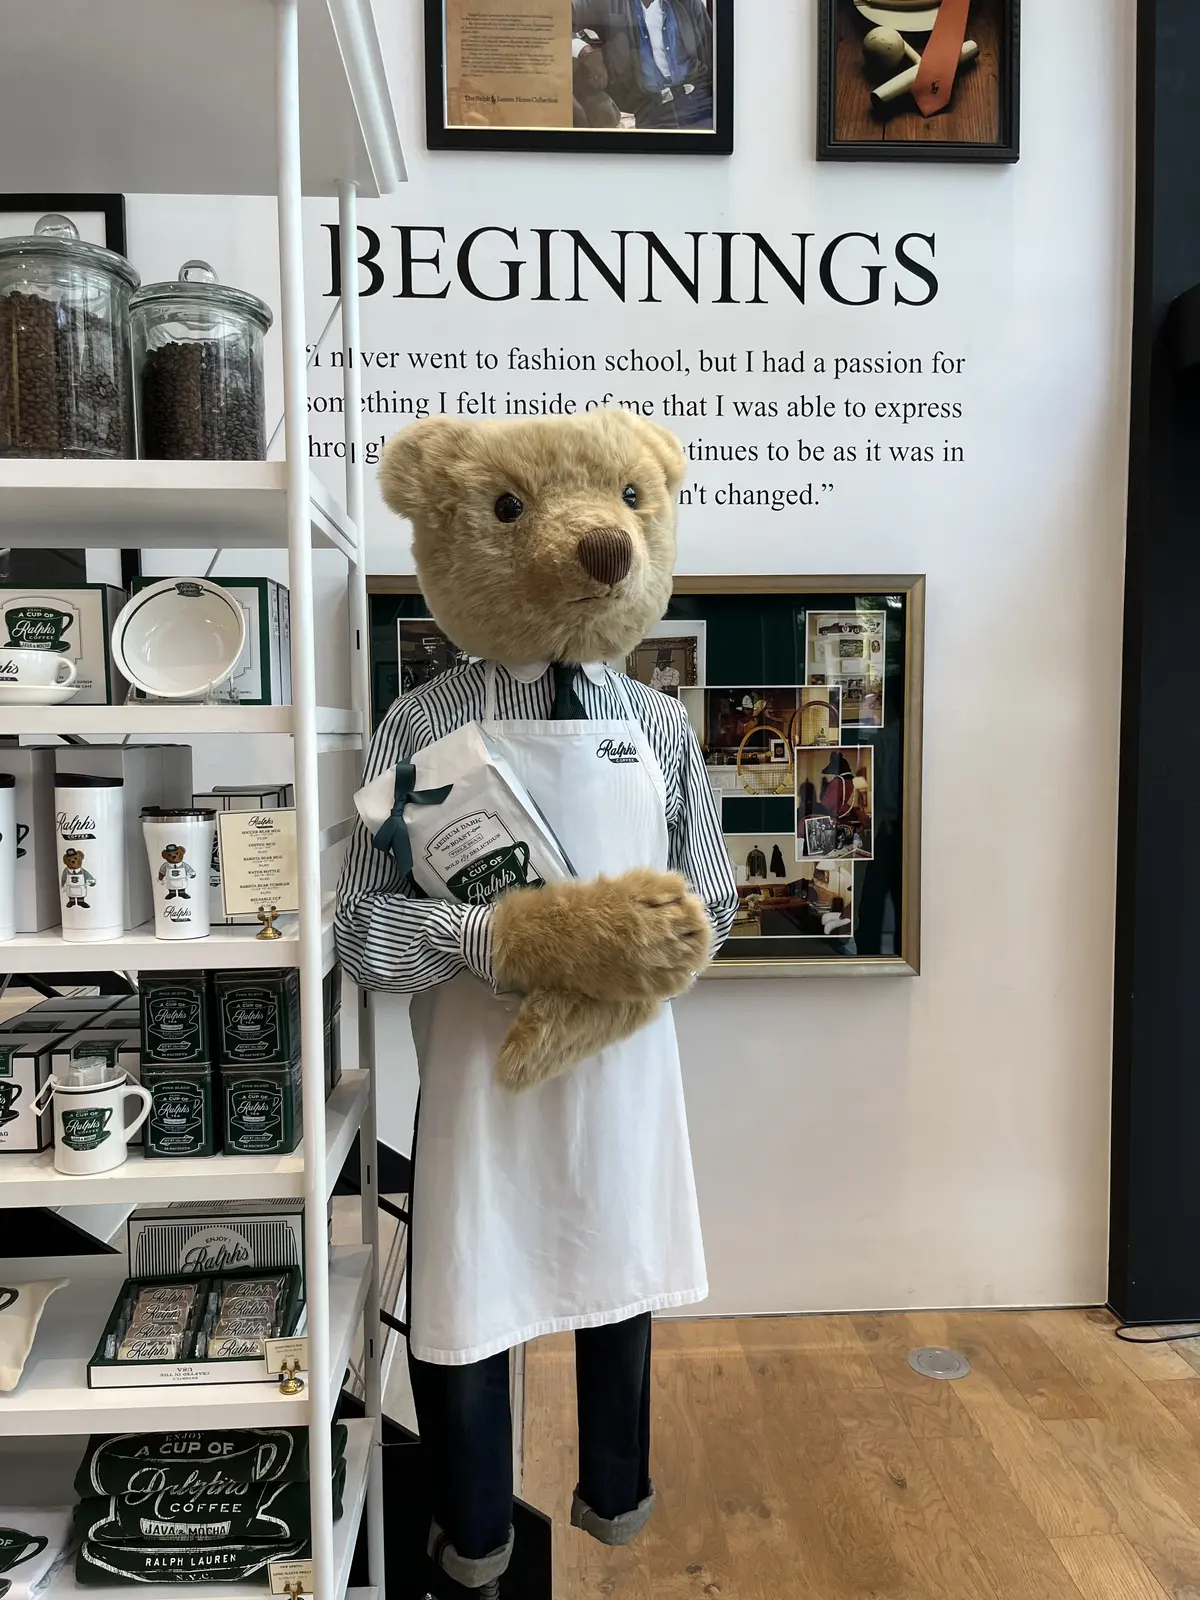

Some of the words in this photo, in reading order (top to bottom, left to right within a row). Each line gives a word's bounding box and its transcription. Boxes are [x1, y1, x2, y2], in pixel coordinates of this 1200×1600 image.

[320, 223, 939, 306] BEGINNINGS
[330, 347, 400, 369] nver
[408, 349, 468, 369] went
[476, 350, 499, 370] to
[507, 347, 597, 371] fashion
[604, 348, 691, 377] school,
[698, 350, 737, 373] but
[745, 350, 754, 373] I
[762, 351, 806, 373] had
[813, 355, 827, 374] a
[832, 350, 923, 379] passion
[931, 351, 966, 374] for
[439, 391, 448, 414] I
[456, 391, 498, 415] felt
[504, 391, 578, 415] inside
[585, 392, 614, 412] of
[618, 400, 655, 416] me
[662, 394, 708, 417] that
[715, 394, 725, 417] I
[732, 400, 779, 418] was
[786, 395, 836, 418] able
[844, 398, 867, 418] to
[874, 401, 963, 424] express
[766, 441, 790, 462] to
[797, 439, 825, 462] be
[833, 443, 858, 462] as
[865, 439, 882, 462] it
[888, 444, 934, 462] was
[942, 440, 965, 462] in
[714, 483, 834, 511] changed.”
[12, 620, 56, 641] Ralph's
[596, 738, 638, 760] Ralph's
[56, 811, 96, 835] Ralph's
[434, 827, 460, 851] MEDIUM
[460, 817, 484, 830] DARK
[449, 830, 472, 847] ROAST
[444, 860, 460, 871] BOLD
[469, 833, 501, 856] DELICIOUS
[461, 876, 468, 884] A
[469, 864, 488, 877] CUP
[489, 856, 503, 866] OF
[467, 868, 517, 905] Ralph's
[163, 905, 192, 919] Ralph's
[158, 1103, 190, 1119] Ralph's
[237, 1101, 269, 1116] Ralph's
[65, 1118, 100, 1136] Ralph's
[181, 1242, 250, 1273] Ralph's
[165, 1432, 205, 1441] ENJOY
[134, 1445, 149, 1457] A
[160, 1442, 201, 1454] CUP
[207, 1441, 235, 1454] OF
[170, 1503, 243, 1513] COFFEE
[145, 1523, 175, 1535] JAVA
[188, 1525, 227, 1537] MOCHA
[145, 1557, 184, 1567] RALPH
[190, 1553, 237, 1567] LAUREN
[176, 1573, 214, 1581] N.Y.C.
